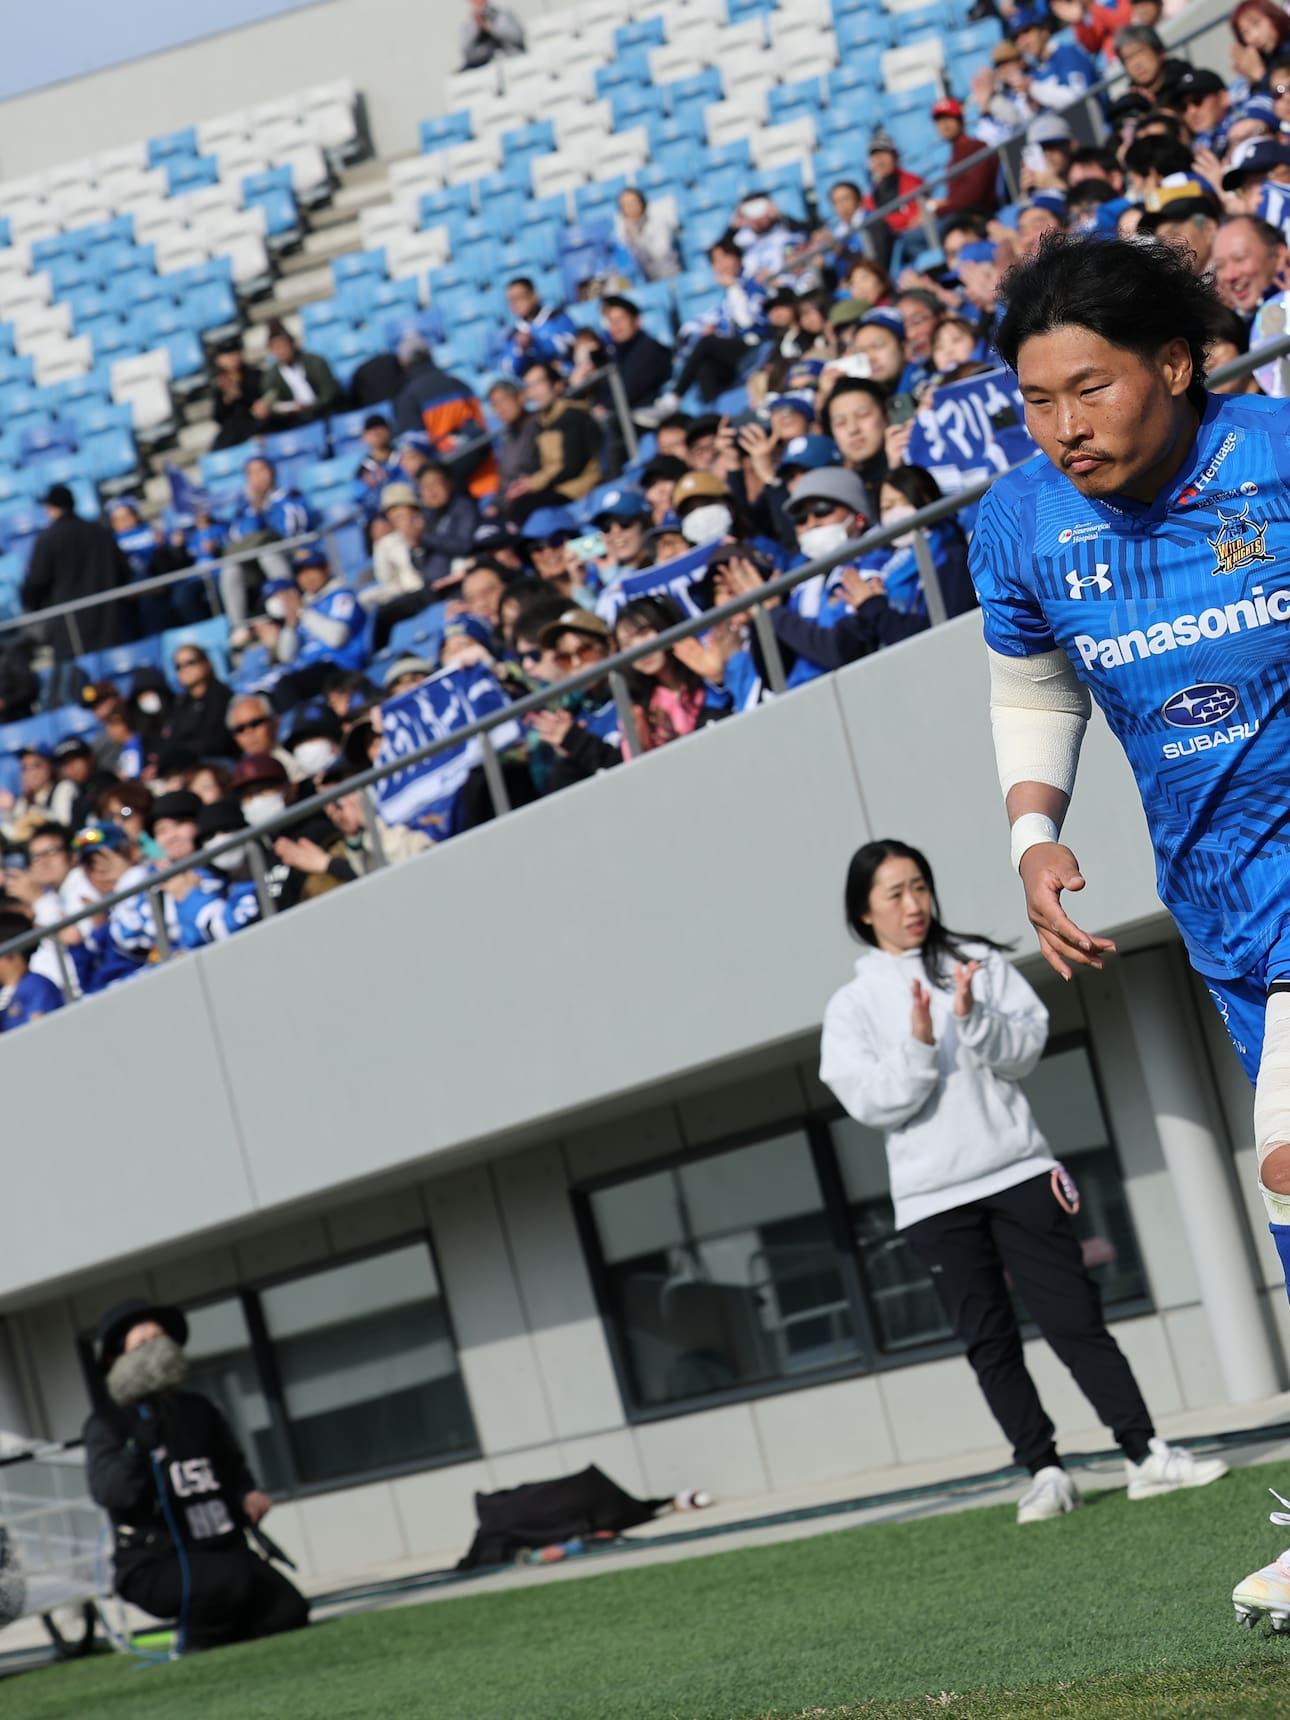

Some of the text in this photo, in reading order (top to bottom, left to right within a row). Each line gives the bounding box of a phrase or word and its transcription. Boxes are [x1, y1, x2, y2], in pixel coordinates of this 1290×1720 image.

[1218, 538, 1243, 560] WILD
[1226, 539, 1262, 570] KNIGHTS
[1162, 720, 1260, 760] SUBARU
